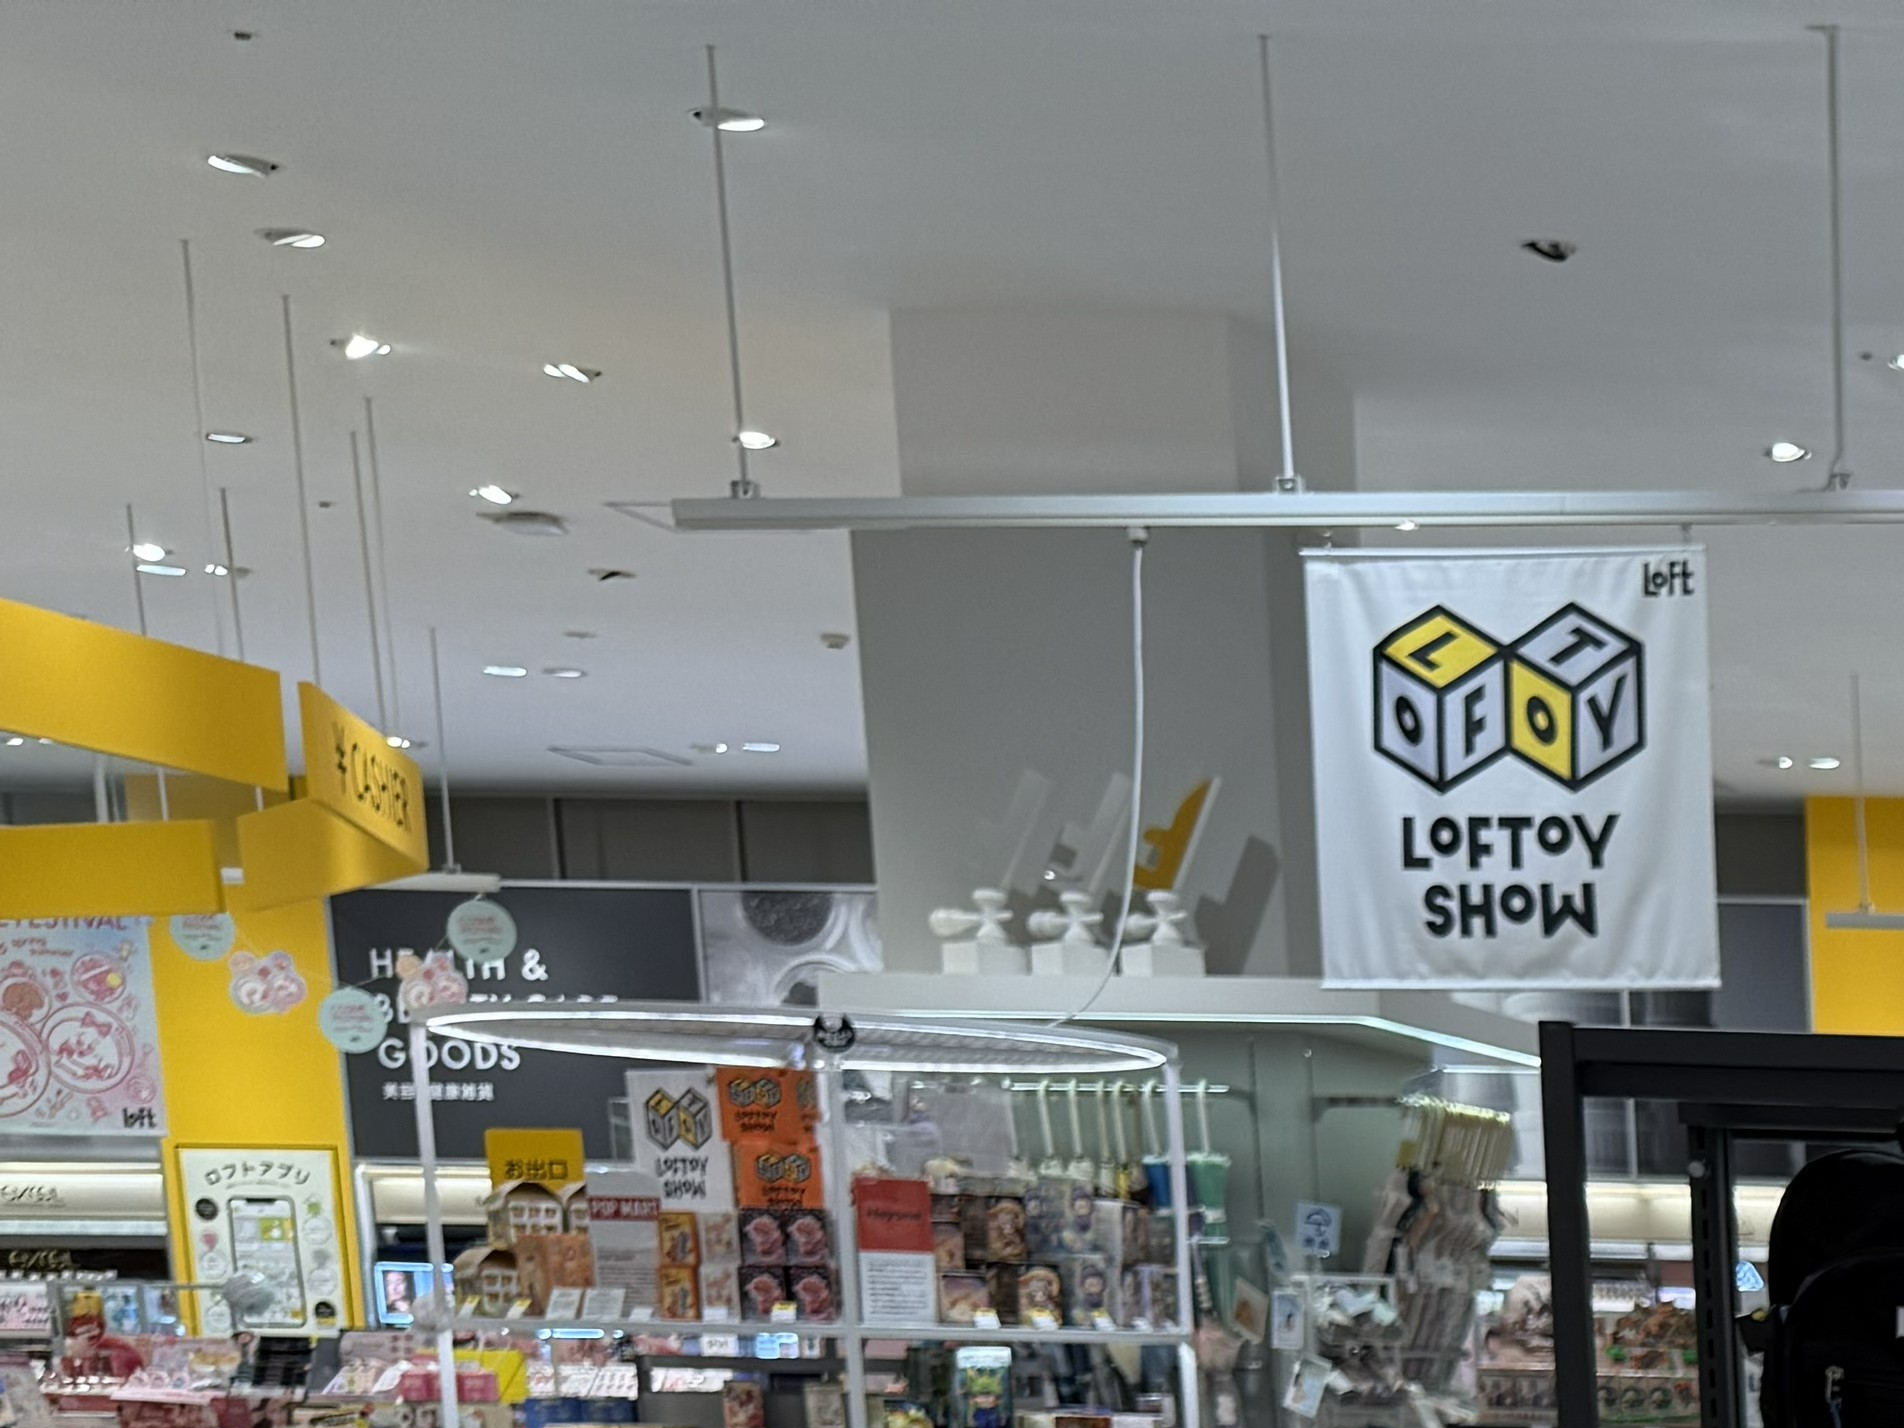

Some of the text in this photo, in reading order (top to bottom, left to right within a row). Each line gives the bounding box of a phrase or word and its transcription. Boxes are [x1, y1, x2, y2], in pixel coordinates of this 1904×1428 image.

[1643, 560, 1695, 597] Loft
[1403, 814, 1620, 870] LOFTOY
[1424, 884, 1597, 938] SHOW
